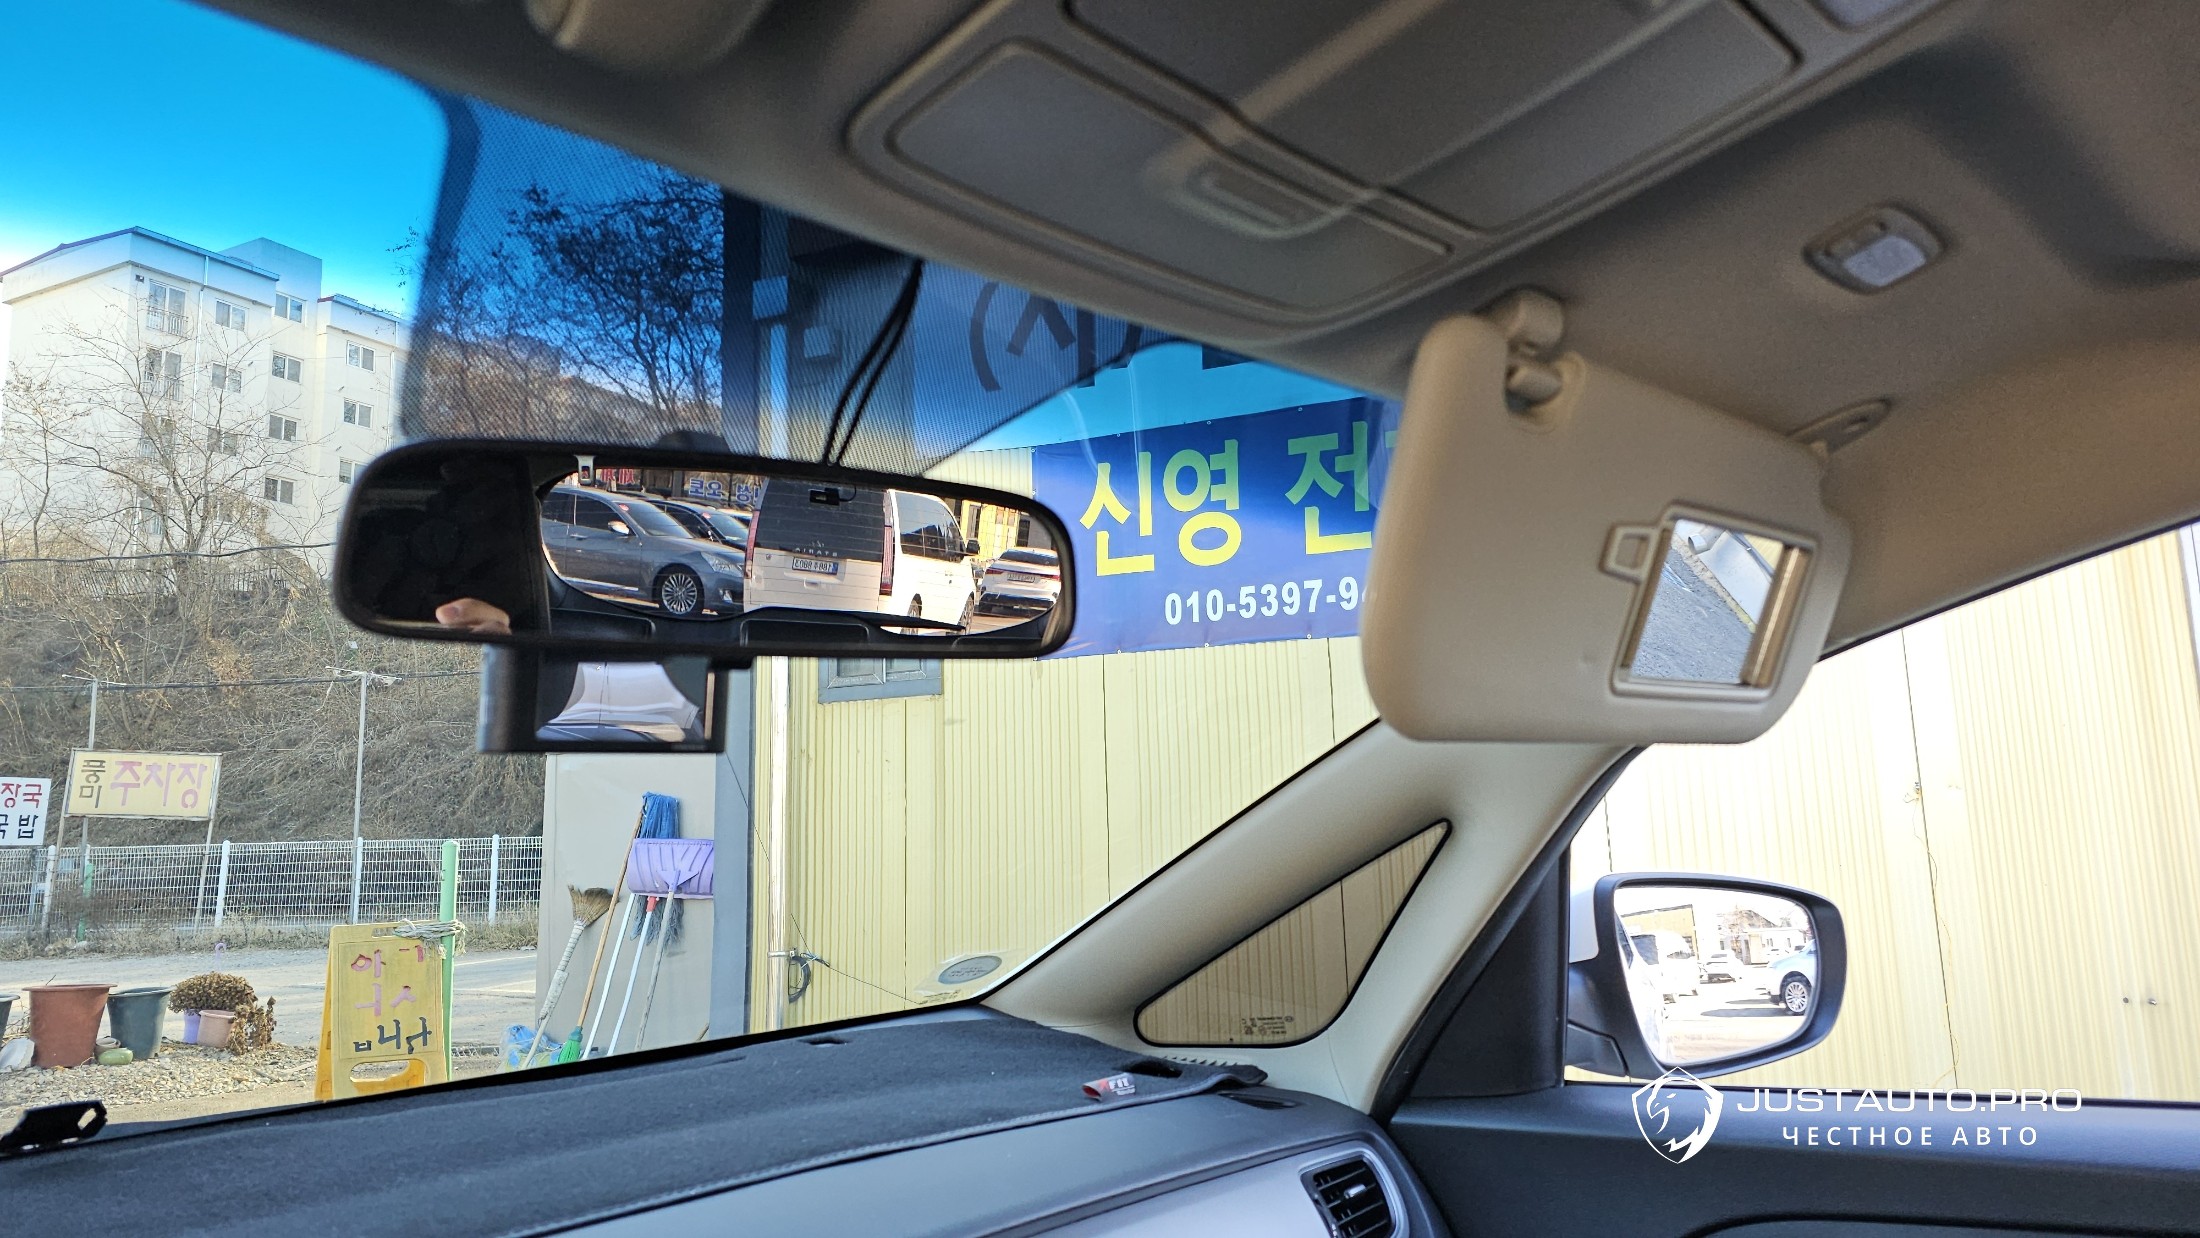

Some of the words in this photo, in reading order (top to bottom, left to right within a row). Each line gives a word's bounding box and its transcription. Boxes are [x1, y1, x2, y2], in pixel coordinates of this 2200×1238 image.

[1079, 438, 1242, 577] 신영
[1284, 420, 1400, 556] 전
[1164, 575, 1370, 625] 010-5397-9
[1, 783, 43, 809] 장국
[78, 759, 107, 809] 풍미
[109, 760, 208, 809] 주차장
